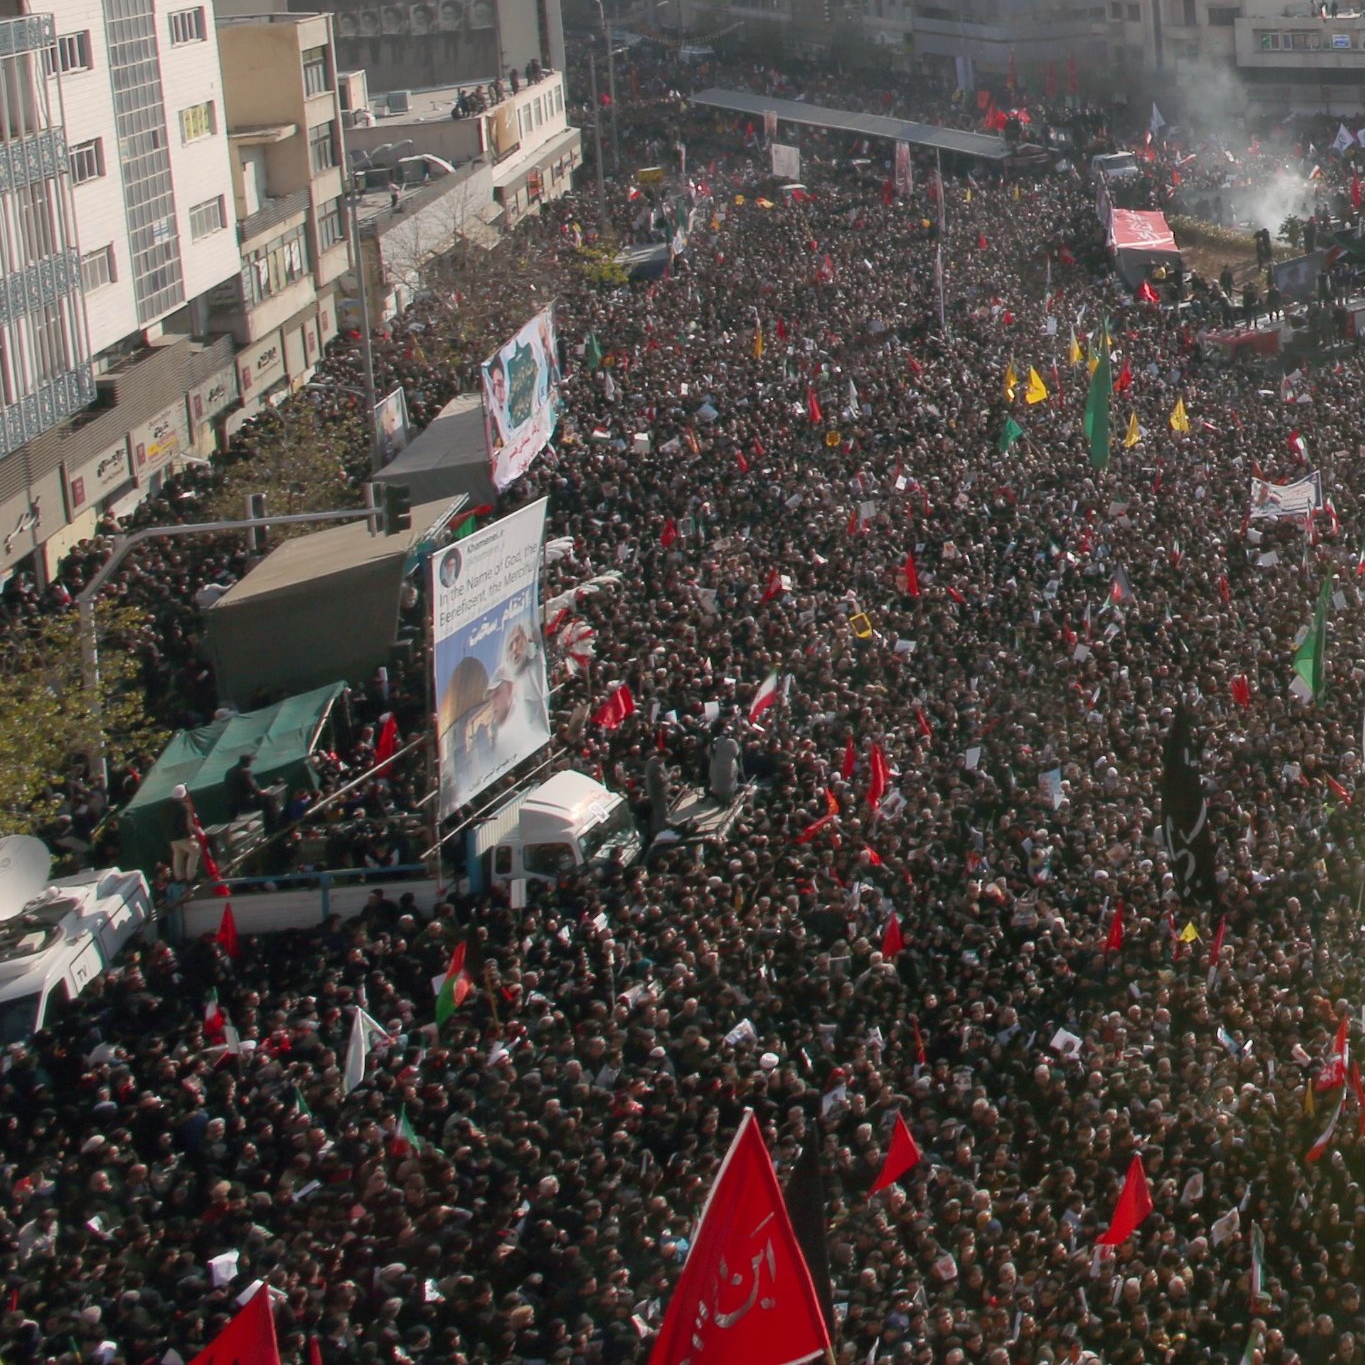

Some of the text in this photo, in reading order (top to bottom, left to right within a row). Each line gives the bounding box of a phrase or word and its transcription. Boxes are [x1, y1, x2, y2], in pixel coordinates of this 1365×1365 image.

[440, 593, 448, 608] In
[450, 583, 464, 600] the
[467, 570, 493, 590] Name
[494, 560, 503, 576] of
[524, 543, 537, 559] the
[489, 579, 503, 594] the
[77, 965, 88, 982] TV
